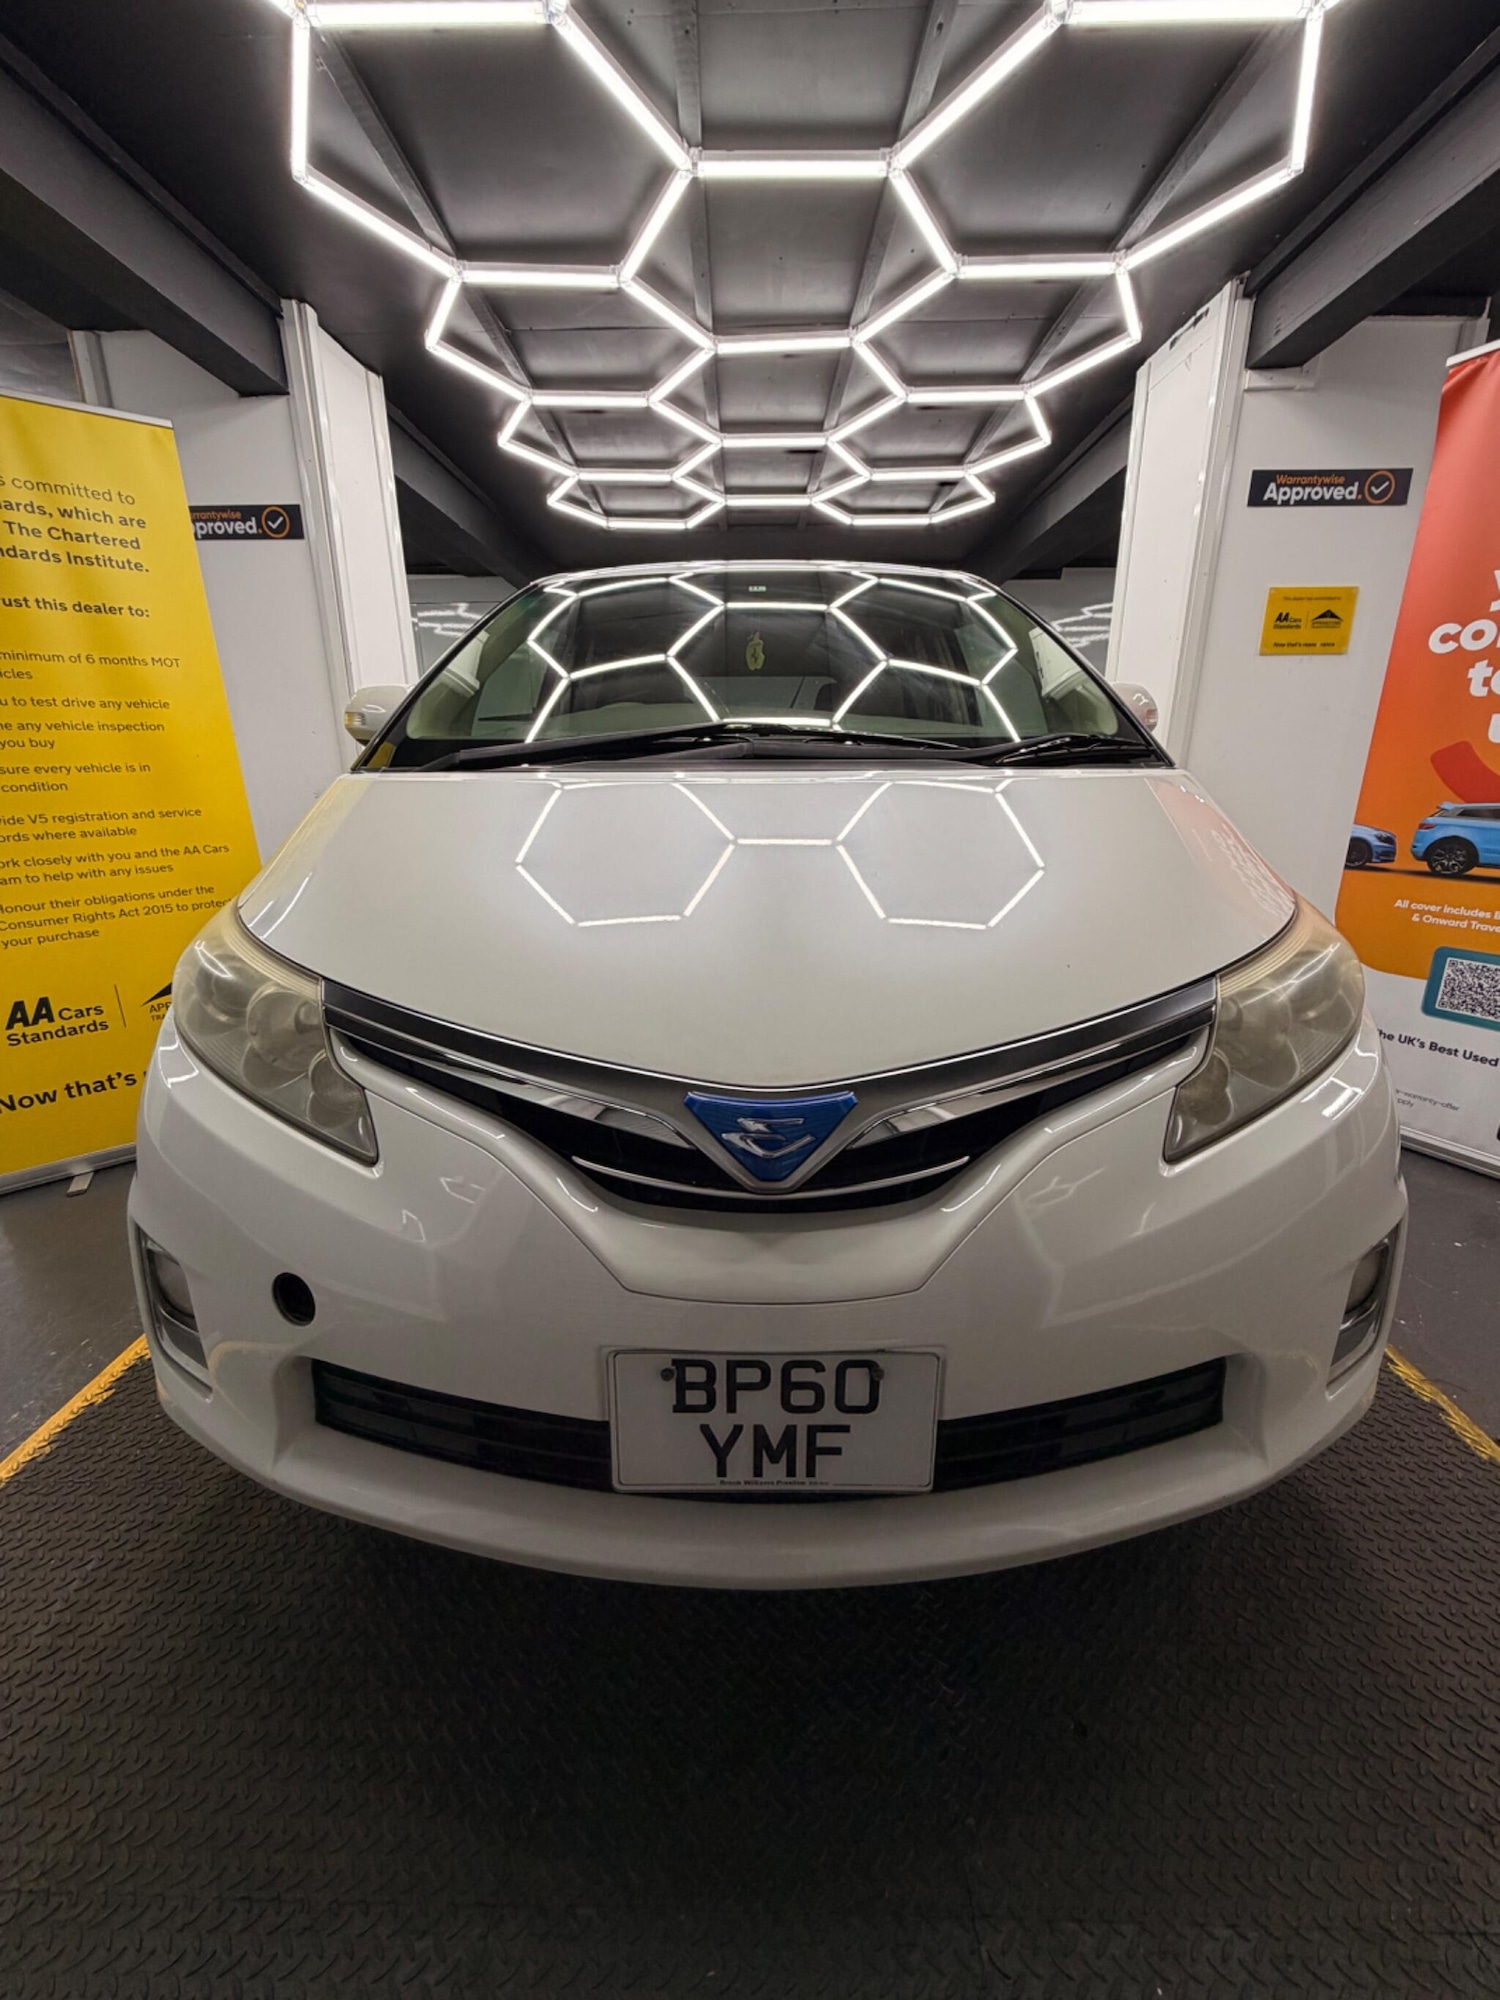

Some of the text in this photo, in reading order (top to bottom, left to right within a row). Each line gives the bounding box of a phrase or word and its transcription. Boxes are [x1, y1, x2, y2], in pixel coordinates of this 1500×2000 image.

[1276, 474, 1346, 486] Warrantywise
[12, 476, 113, 502] committed
[118, 491, 136, 506] to
[57, 507, 114, 525] which
[119, 516, 147, 529] are
[3, 520, 141, 550] The Chartered
[66, 552, 150, 573] Institute.
[35, 598, 68, 612] this
[72, 601, 124, 615] dealer
[128, 605, 150, 618] to:
[68, 652, 83, 664] of
[85, 653, 96, 665] 6
[99, 655, 149, 667] months
[151, 657, 181, 668] MOT
[12, 696, 27, 707] to
[31, 697, 58, 707] test
[62, 697, 96, 708] drive
[99, 701, 122, 711] any
[125, 699, 170, 710] vehicle
[17, 722, 42, 733] any
[45, 720, 94, 731] vehicle
[97, 721, 165, 733] inspection
[0, 738, 55, 751] you buy
[34, 765, 72, 776] every
[75, 763, 122, 774] vehicle
[125, 762, 136, 773] is
[139, 762, 151, 772] in
[1, 781, 68, 793] condition
[27, 814, 48, 826] V5
[52, 810, 129, 824] registration
[132, 808, 155, 820] and
[158, 807, 202, 819] service
[33, 829, 77, 841] where
[80, 826, 137, 838] available
[24, 854, 72, 869] closely
[76, 851, 105, 864] with
[108, 851, 131, 864] you
[134, 848, 158, 859] and
[161, 847, 180, 858] the
[183, 845, 201, 856] AA
[203, 844, 230, 854] Cars
[25, 873, 40, 884] to
[43, 869, 74, 883] help
[77, 867, 106, 880] with
[109, 867, 132, 880] any
[135, 863, 174, 875] issues
[49, 897, 81, 910] their
[84, 892, 156, 908] obligations
[158, 887, 192, 900] under
[195, 885, 215, 895] the
[0, 916, 70, 932] Consumer
[73, 909, 116, 924] Rights
[119, 908, 140, 919] Act
[143, 903, 173, 916] 2015
[176, 901, 189, 912] to
[1394, 899, 1410, 909] All
[1411, 902, 1441, 912] cover
[1443, 904, 1491, 919] includes
[1412, 913, 1420, 922] &
[1422, 914, 1468, 929] Onward
[1, 928, 100, 950] your purchase
[5, 996, 104, 1030] AA Cars
[6, 1019, 109, 1047] Standards
[1398, 1033, 1426, 1049] UK's
[1429, 1041, 1459, 1057] Best
[1462, 1049, 1499, 1067] Used
[0, 1071, 137, 1114] Now that's
[671, 1358, 881, 1415] BP60
[700, 1424, 850, 1478] YMF
